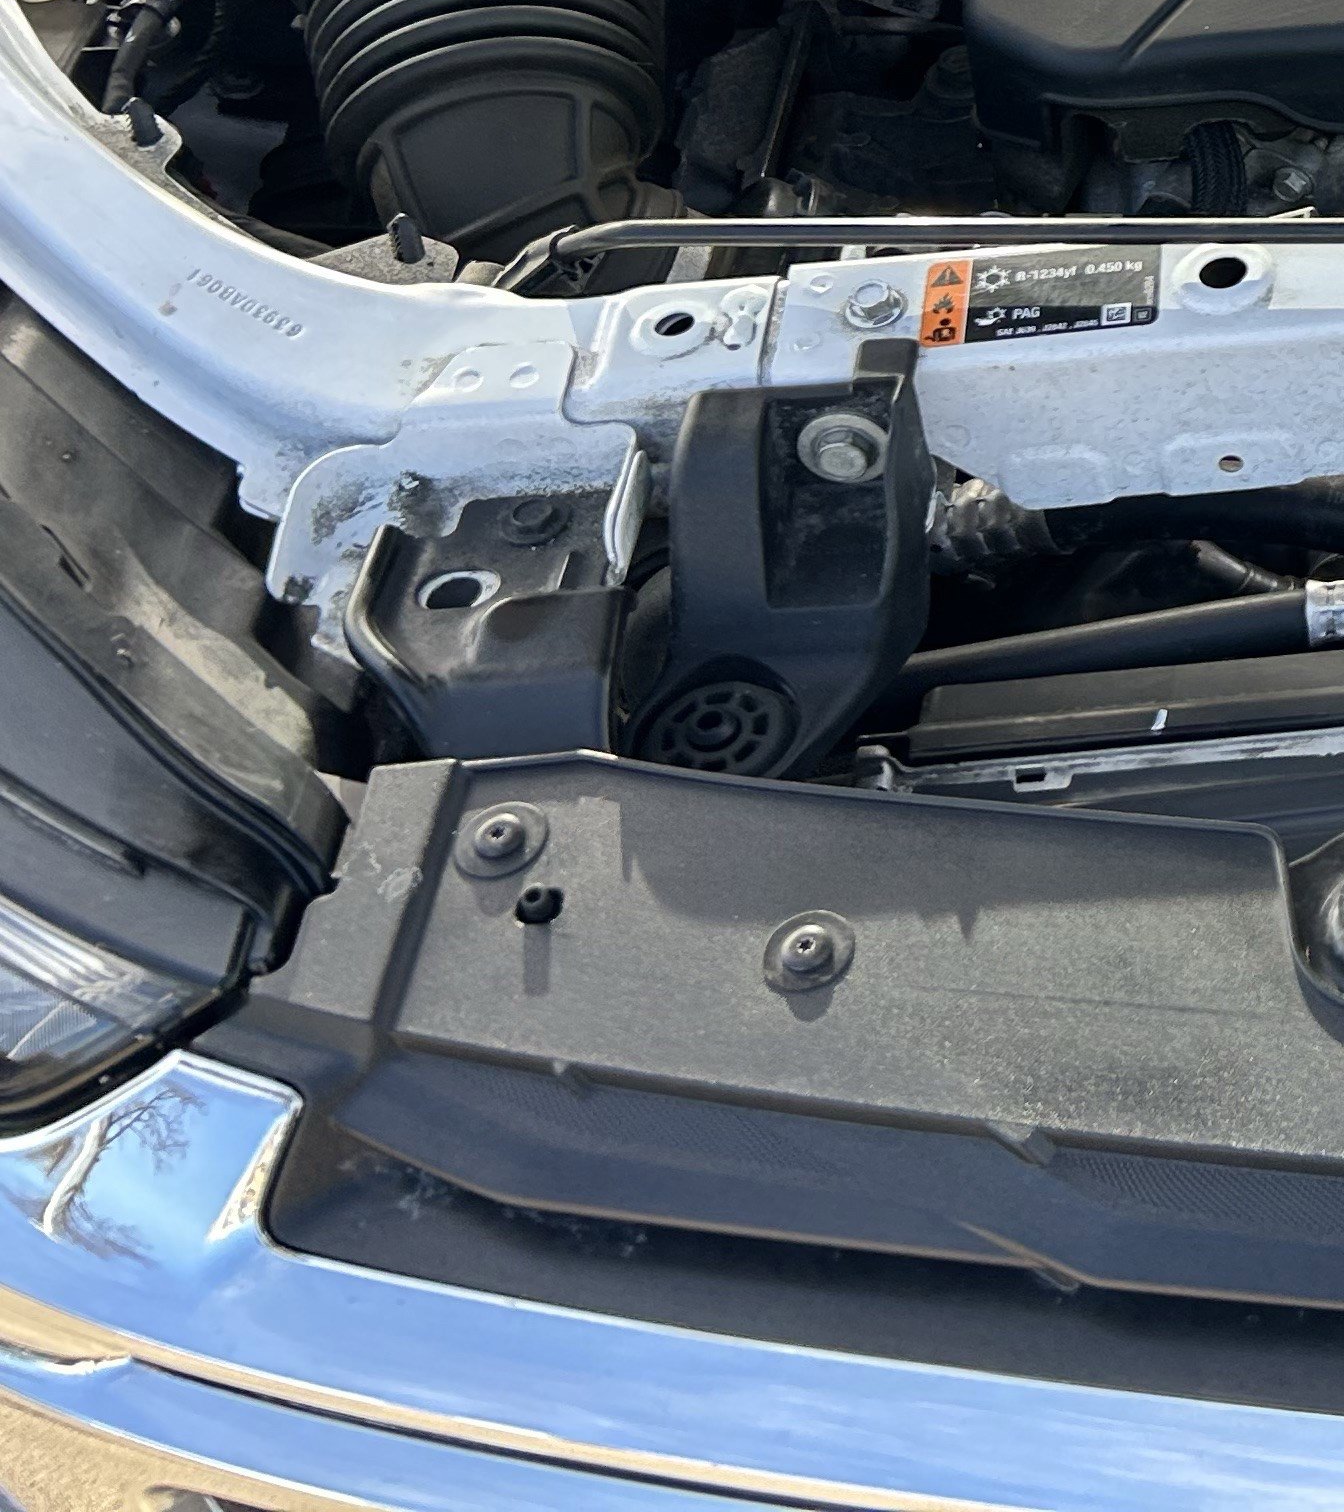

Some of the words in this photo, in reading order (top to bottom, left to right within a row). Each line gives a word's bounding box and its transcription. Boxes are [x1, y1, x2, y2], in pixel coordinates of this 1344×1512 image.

[1015, 266, 1078, 282] R-1234yf
[1084, 261, 1123, 275] 0.450
[1125, 260, 1143, 273] kg
[1011, 306, 1041, 320] PAG
